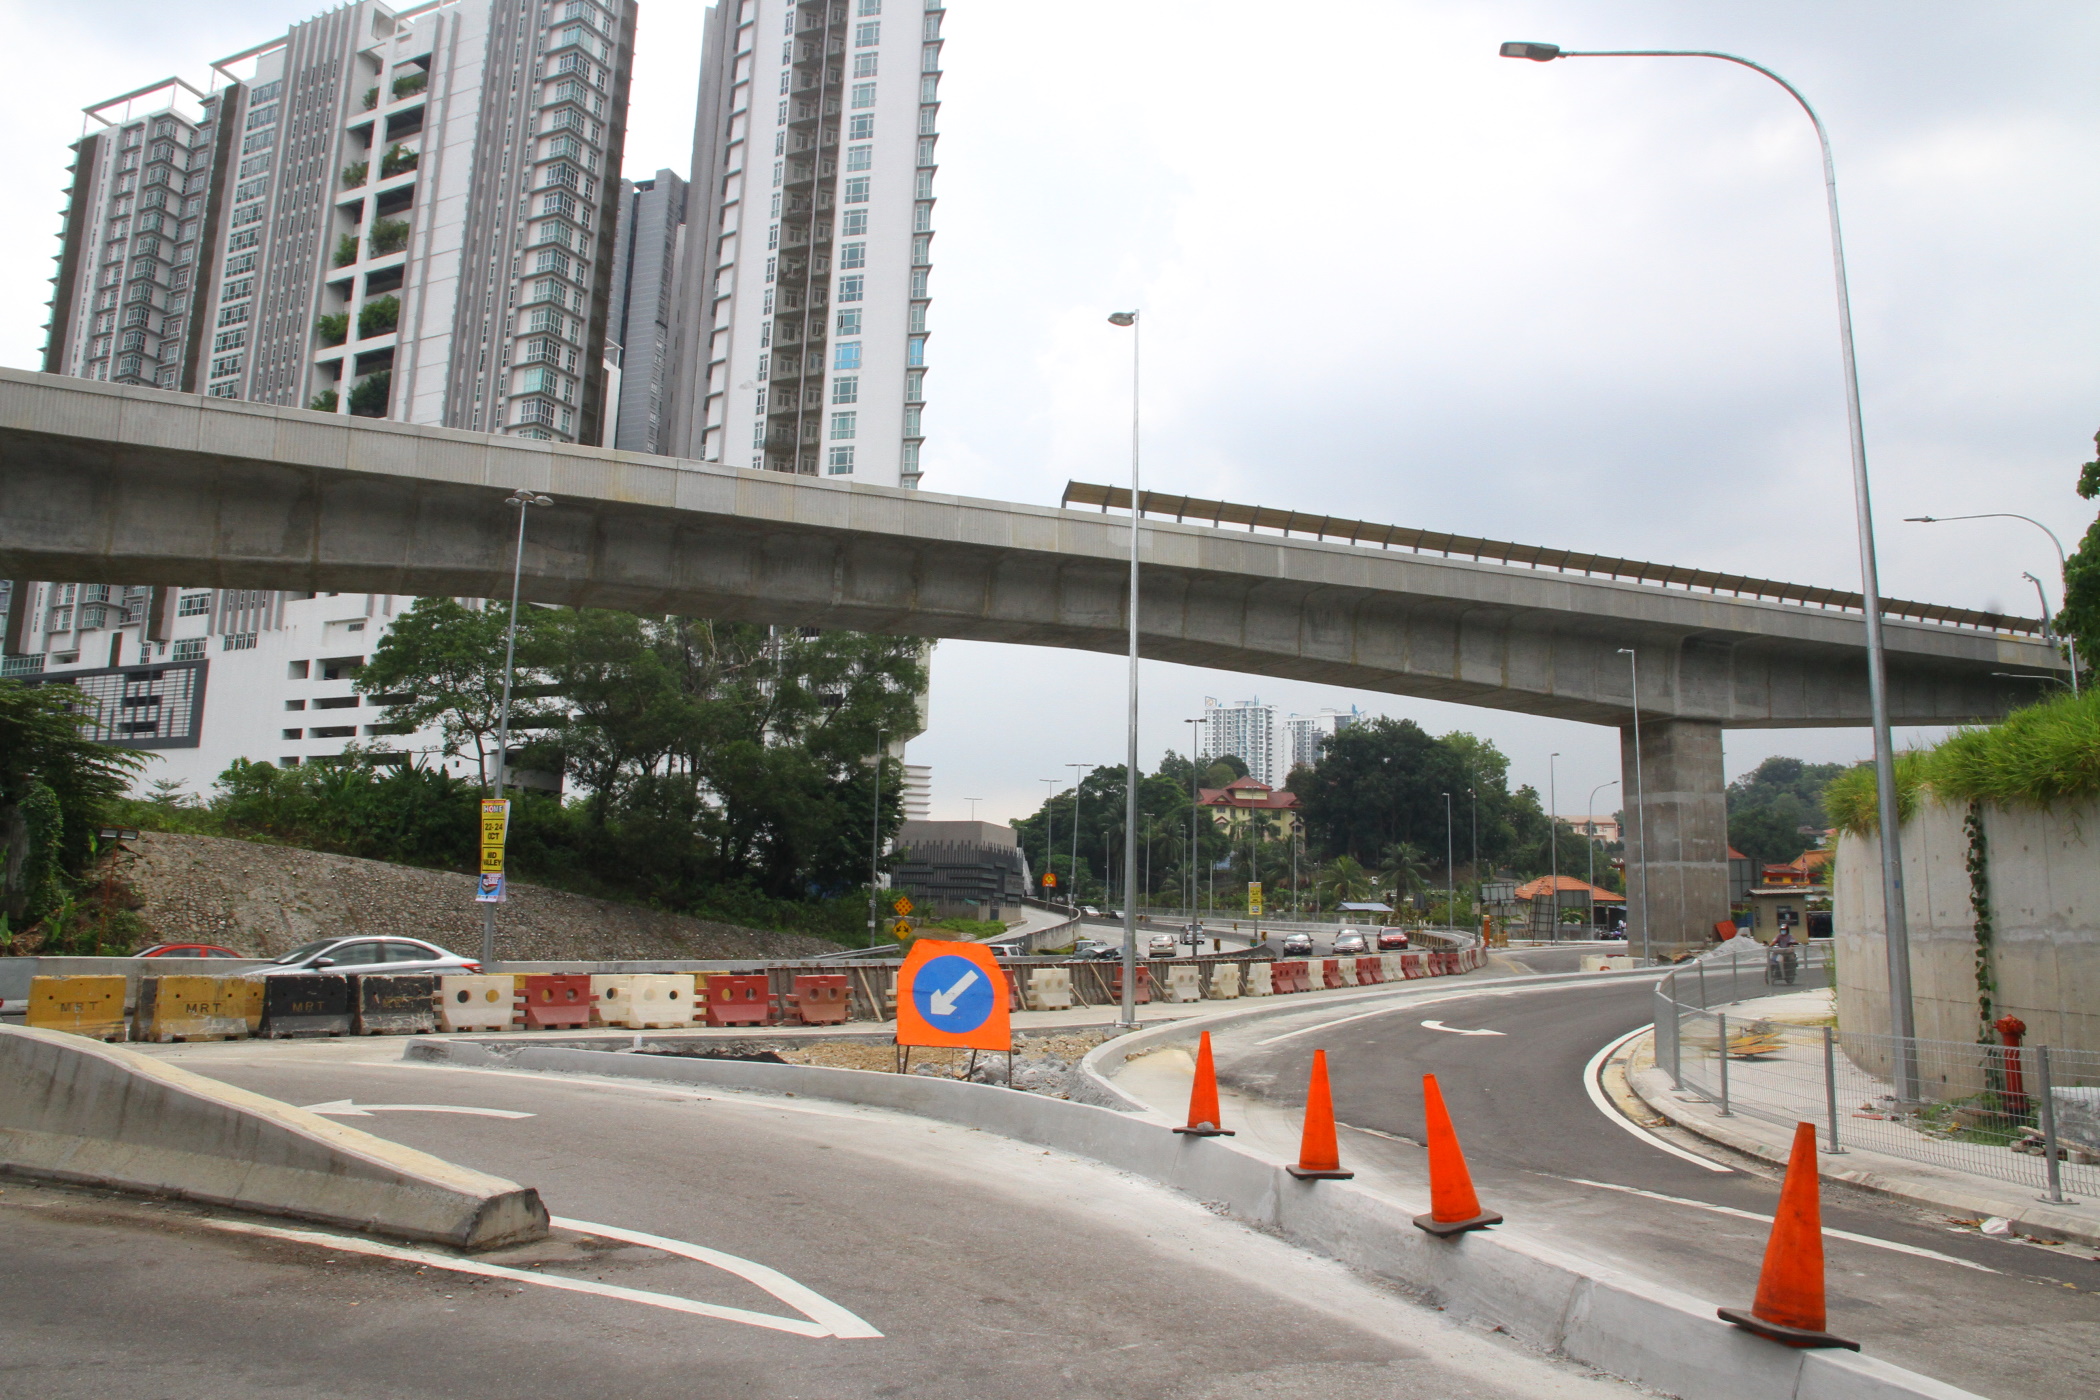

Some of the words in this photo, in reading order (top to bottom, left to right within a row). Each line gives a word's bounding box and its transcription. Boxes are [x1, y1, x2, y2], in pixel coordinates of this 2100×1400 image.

[60, 1001, 98, 1013] MRT
[185, 1003, 222, 1014] MRT
[292, 1001, 325, 1012] MRT
